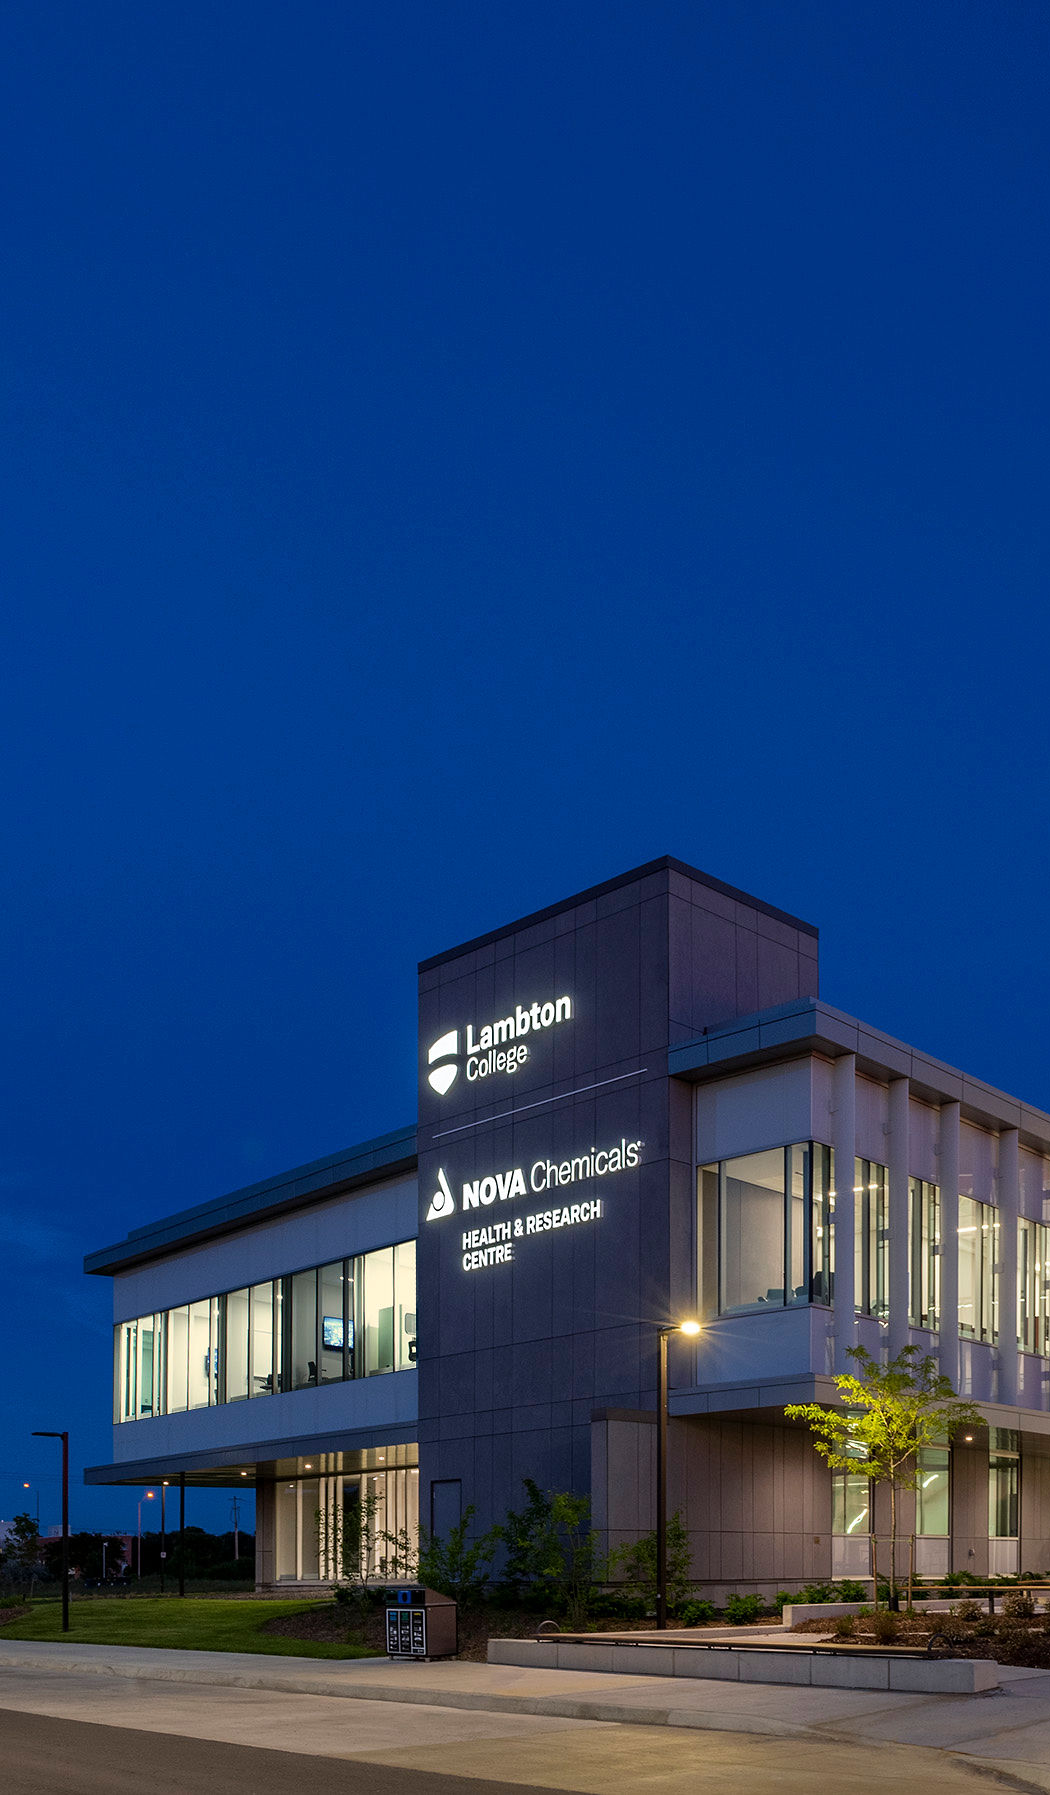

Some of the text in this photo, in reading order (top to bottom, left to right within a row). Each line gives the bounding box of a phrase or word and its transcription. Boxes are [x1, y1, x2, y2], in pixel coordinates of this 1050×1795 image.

[466, 995, 571, 1056] Lambton
[466, 1044, 528, 1082] College
[462, 1138, 640, 1211] NOVA Chemicals
[462, 1198, 601, 1251] HEALTH & RESEARCH
[462, 1242, 513, 1272] CENTRE
